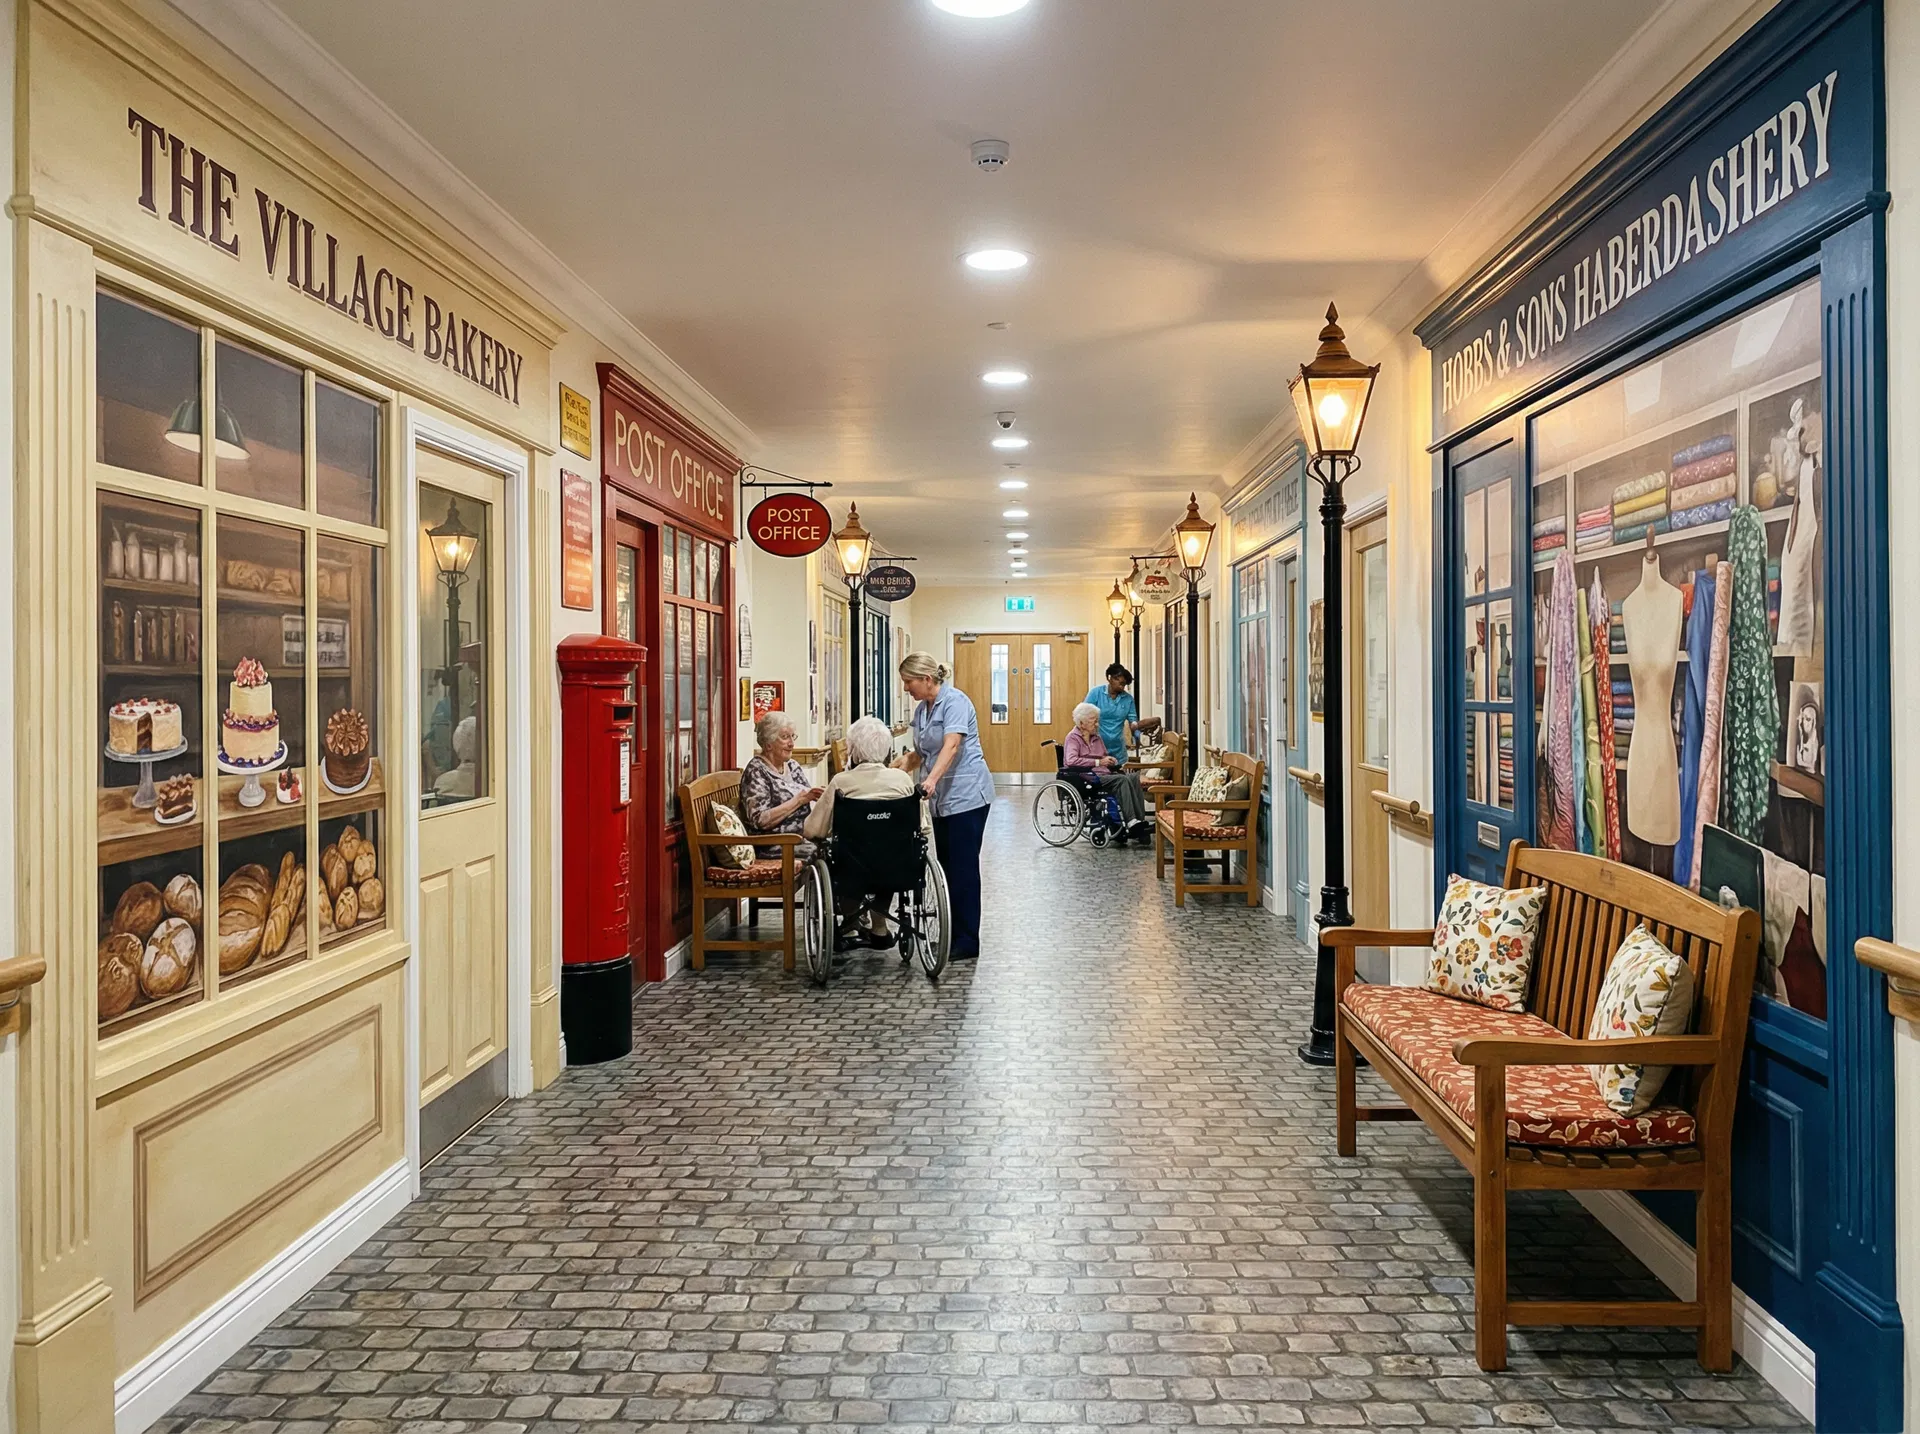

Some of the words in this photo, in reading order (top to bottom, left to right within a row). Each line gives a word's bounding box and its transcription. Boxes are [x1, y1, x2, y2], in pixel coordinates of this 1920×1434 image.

[128, 107, 239, 257] THE
[254, 187, 415, 350] VILLAGE
[423, 294, 524, 406] BAKERY
[1441, 326, 1494, 415] HOBBS
[1496, 317, 1511, 380] &
[1515, 275, 1567, 368] SONS
[1572, 69, 1839, 333] HABERDASHERY
[614, 409, 666, 490] POST
[669, 448, 724, 521] OFFICE
[766, 507, 813, 523] POST
[757, 525, 821, 541] OFFICE
